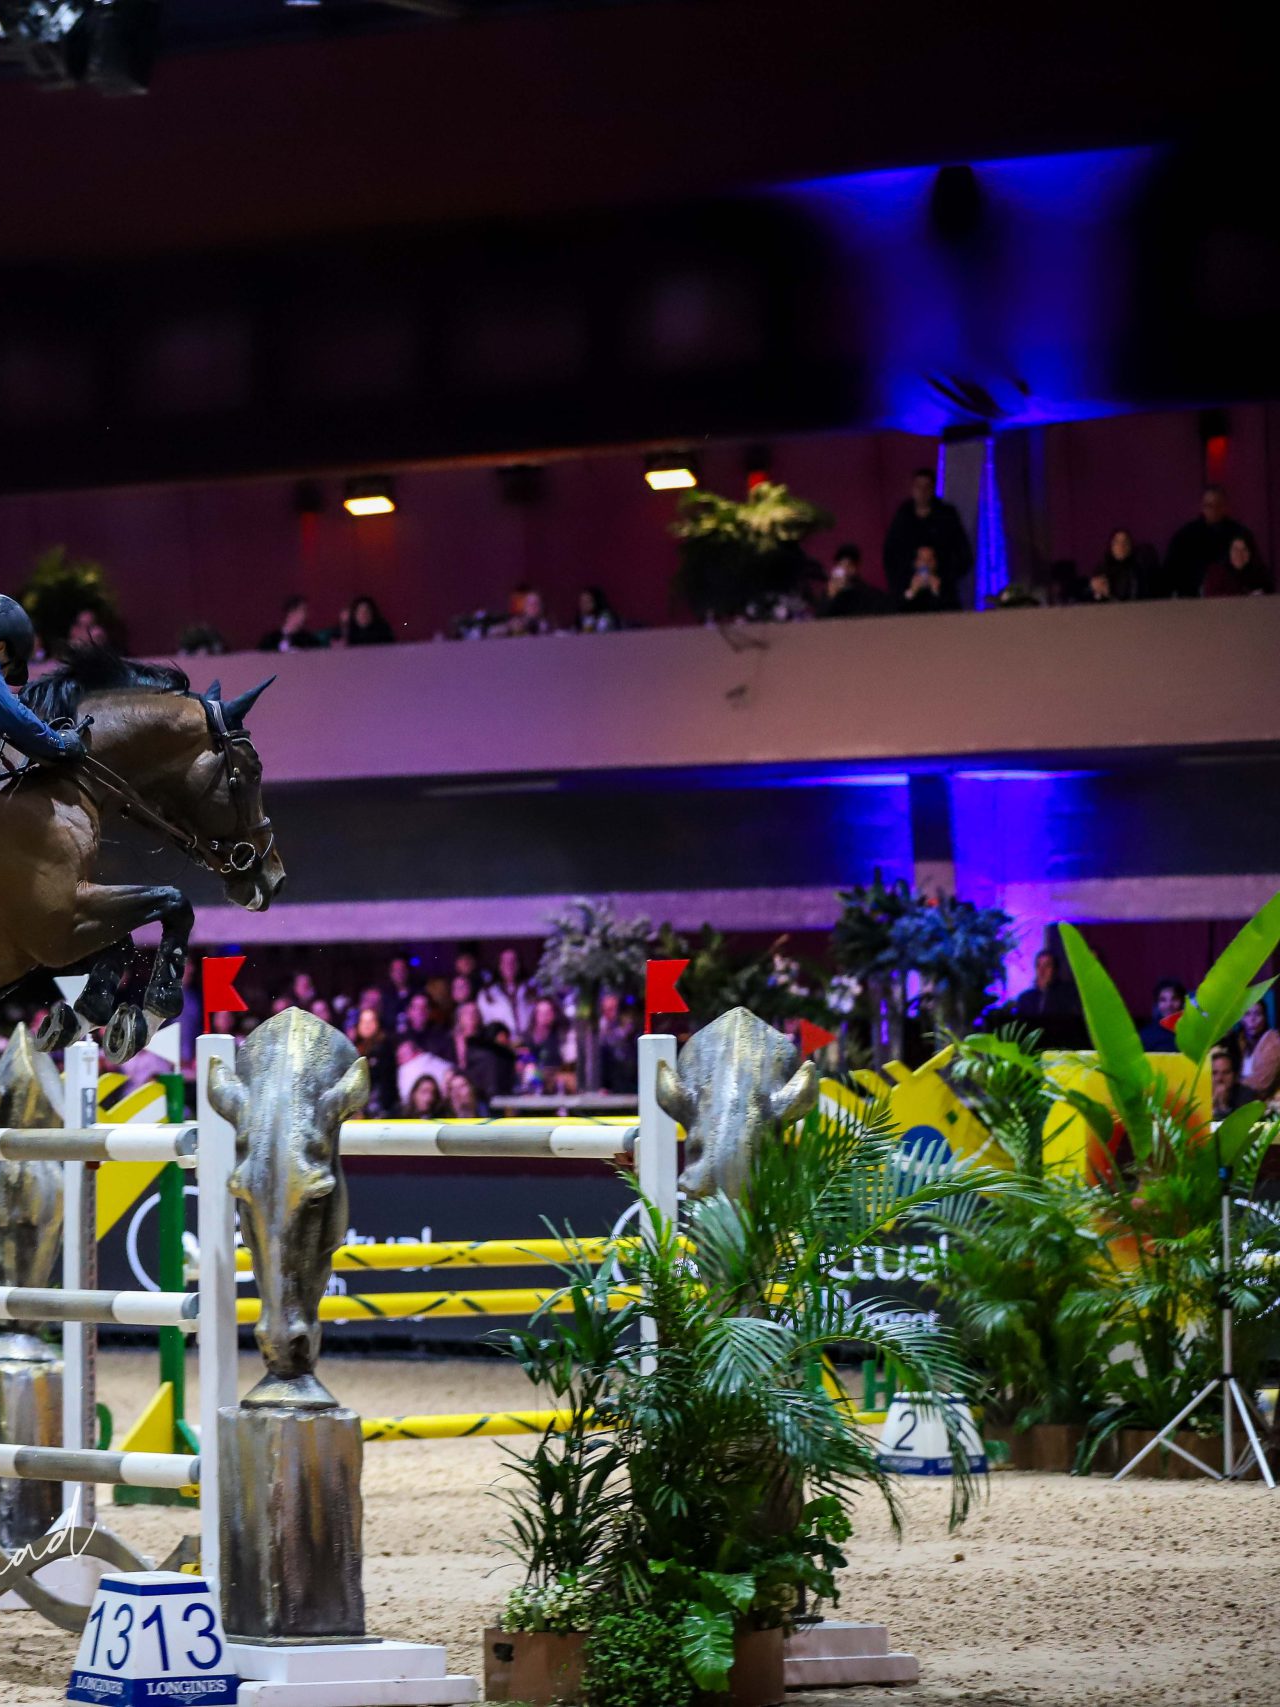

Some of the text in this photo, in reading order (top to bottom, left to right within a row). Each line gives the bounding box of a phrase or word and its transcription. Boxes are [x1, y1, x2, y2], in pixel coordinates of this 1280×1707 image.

[893, 1410, 919, 1451] 2
[89, 1601, 134, 1670] 13
[141, 1602, 223, 1671] 13
[76, 1676, 124, 1695] LONGINES
[146, 1679, 228, 1696] LONGINES
